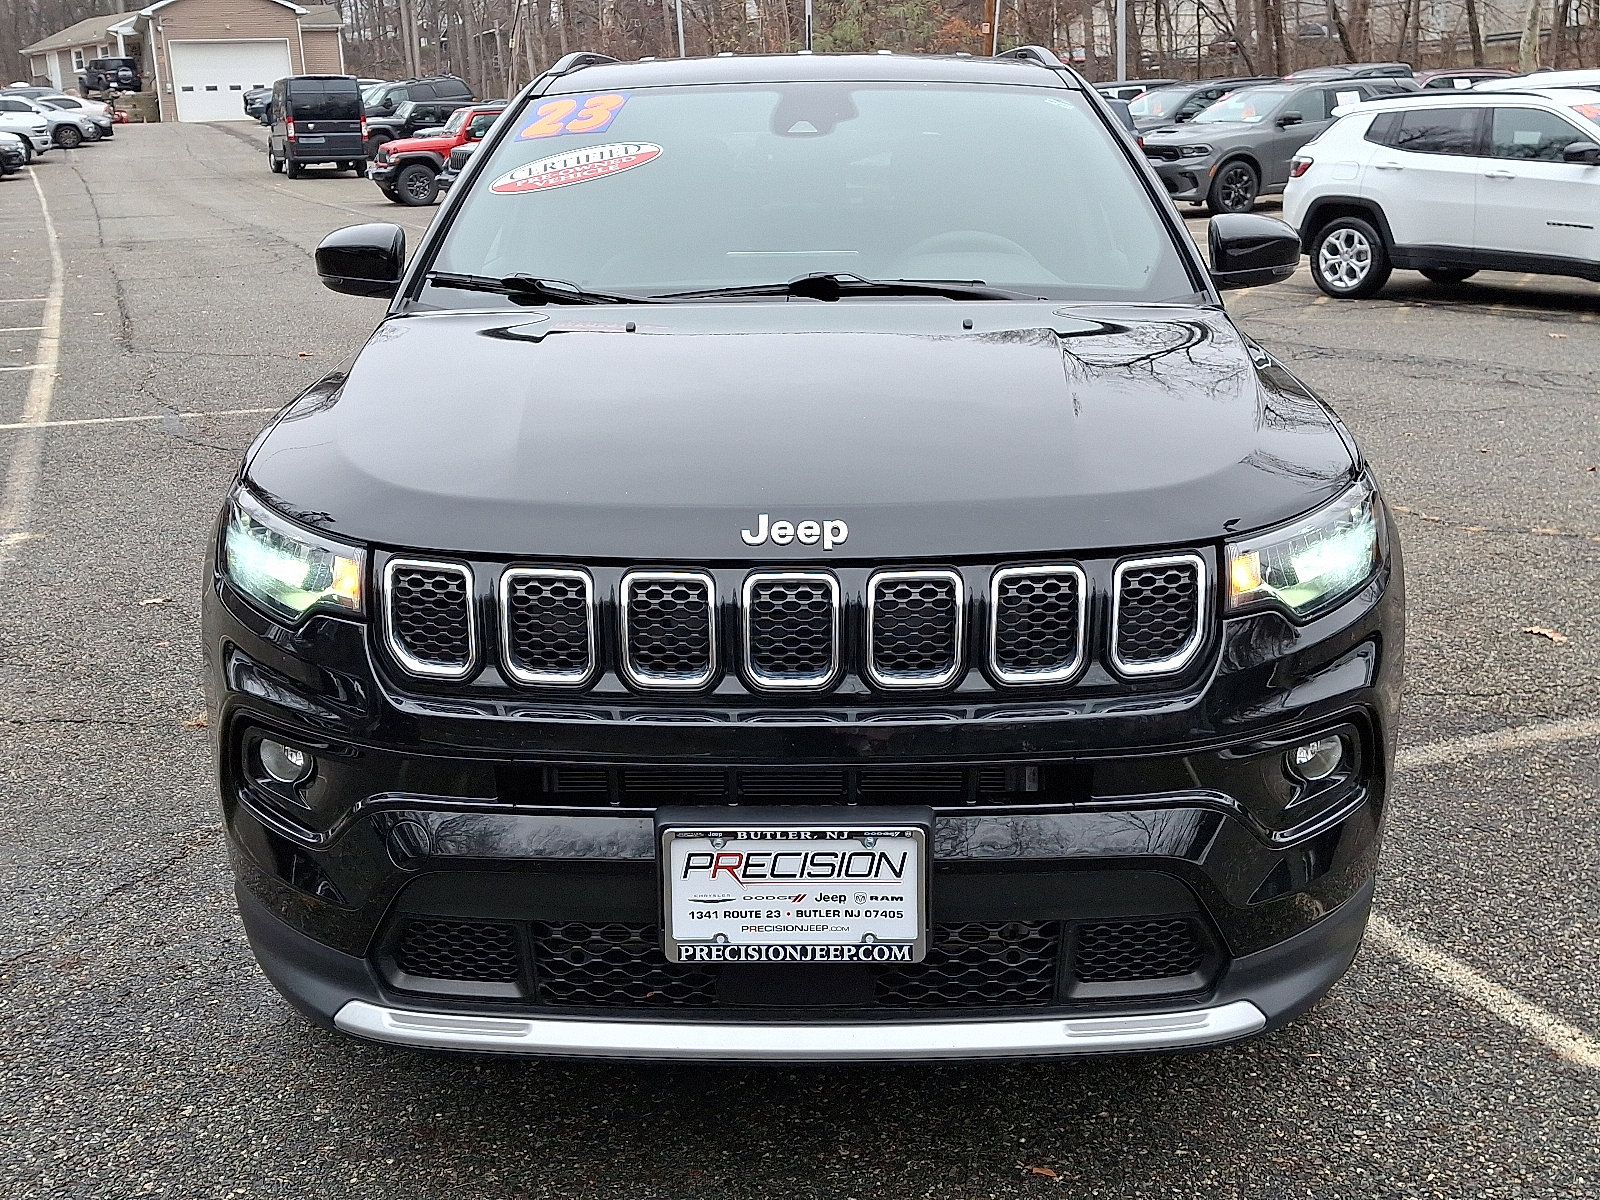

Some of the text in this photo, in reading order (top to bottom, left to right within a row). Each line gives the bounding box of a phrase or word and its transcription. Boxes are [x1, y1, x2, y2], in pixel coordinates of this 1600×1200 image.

[520, 94, 626, 139] 23
[510, 143, 641, 180] CERTIFIED
[515, 155, 637, 187] PRE-OWNED
[533, 164, 620, 187] VEHICLE
[740, 513, 849, 551] Jeep
[736, 831, 849, 840] BUTLER, NJ
[682, 851, 908, 883] PRECISION
[814, 892, 847, 904] Jeep
[688, 909, 904, 920] 1341 ROUTE 23 BUTLER NJ 07405
[741, 924, 850, 933] PRECISIONJEEP.COM
[679, 944, 913, 962] PRECISIONJEEP.COM
